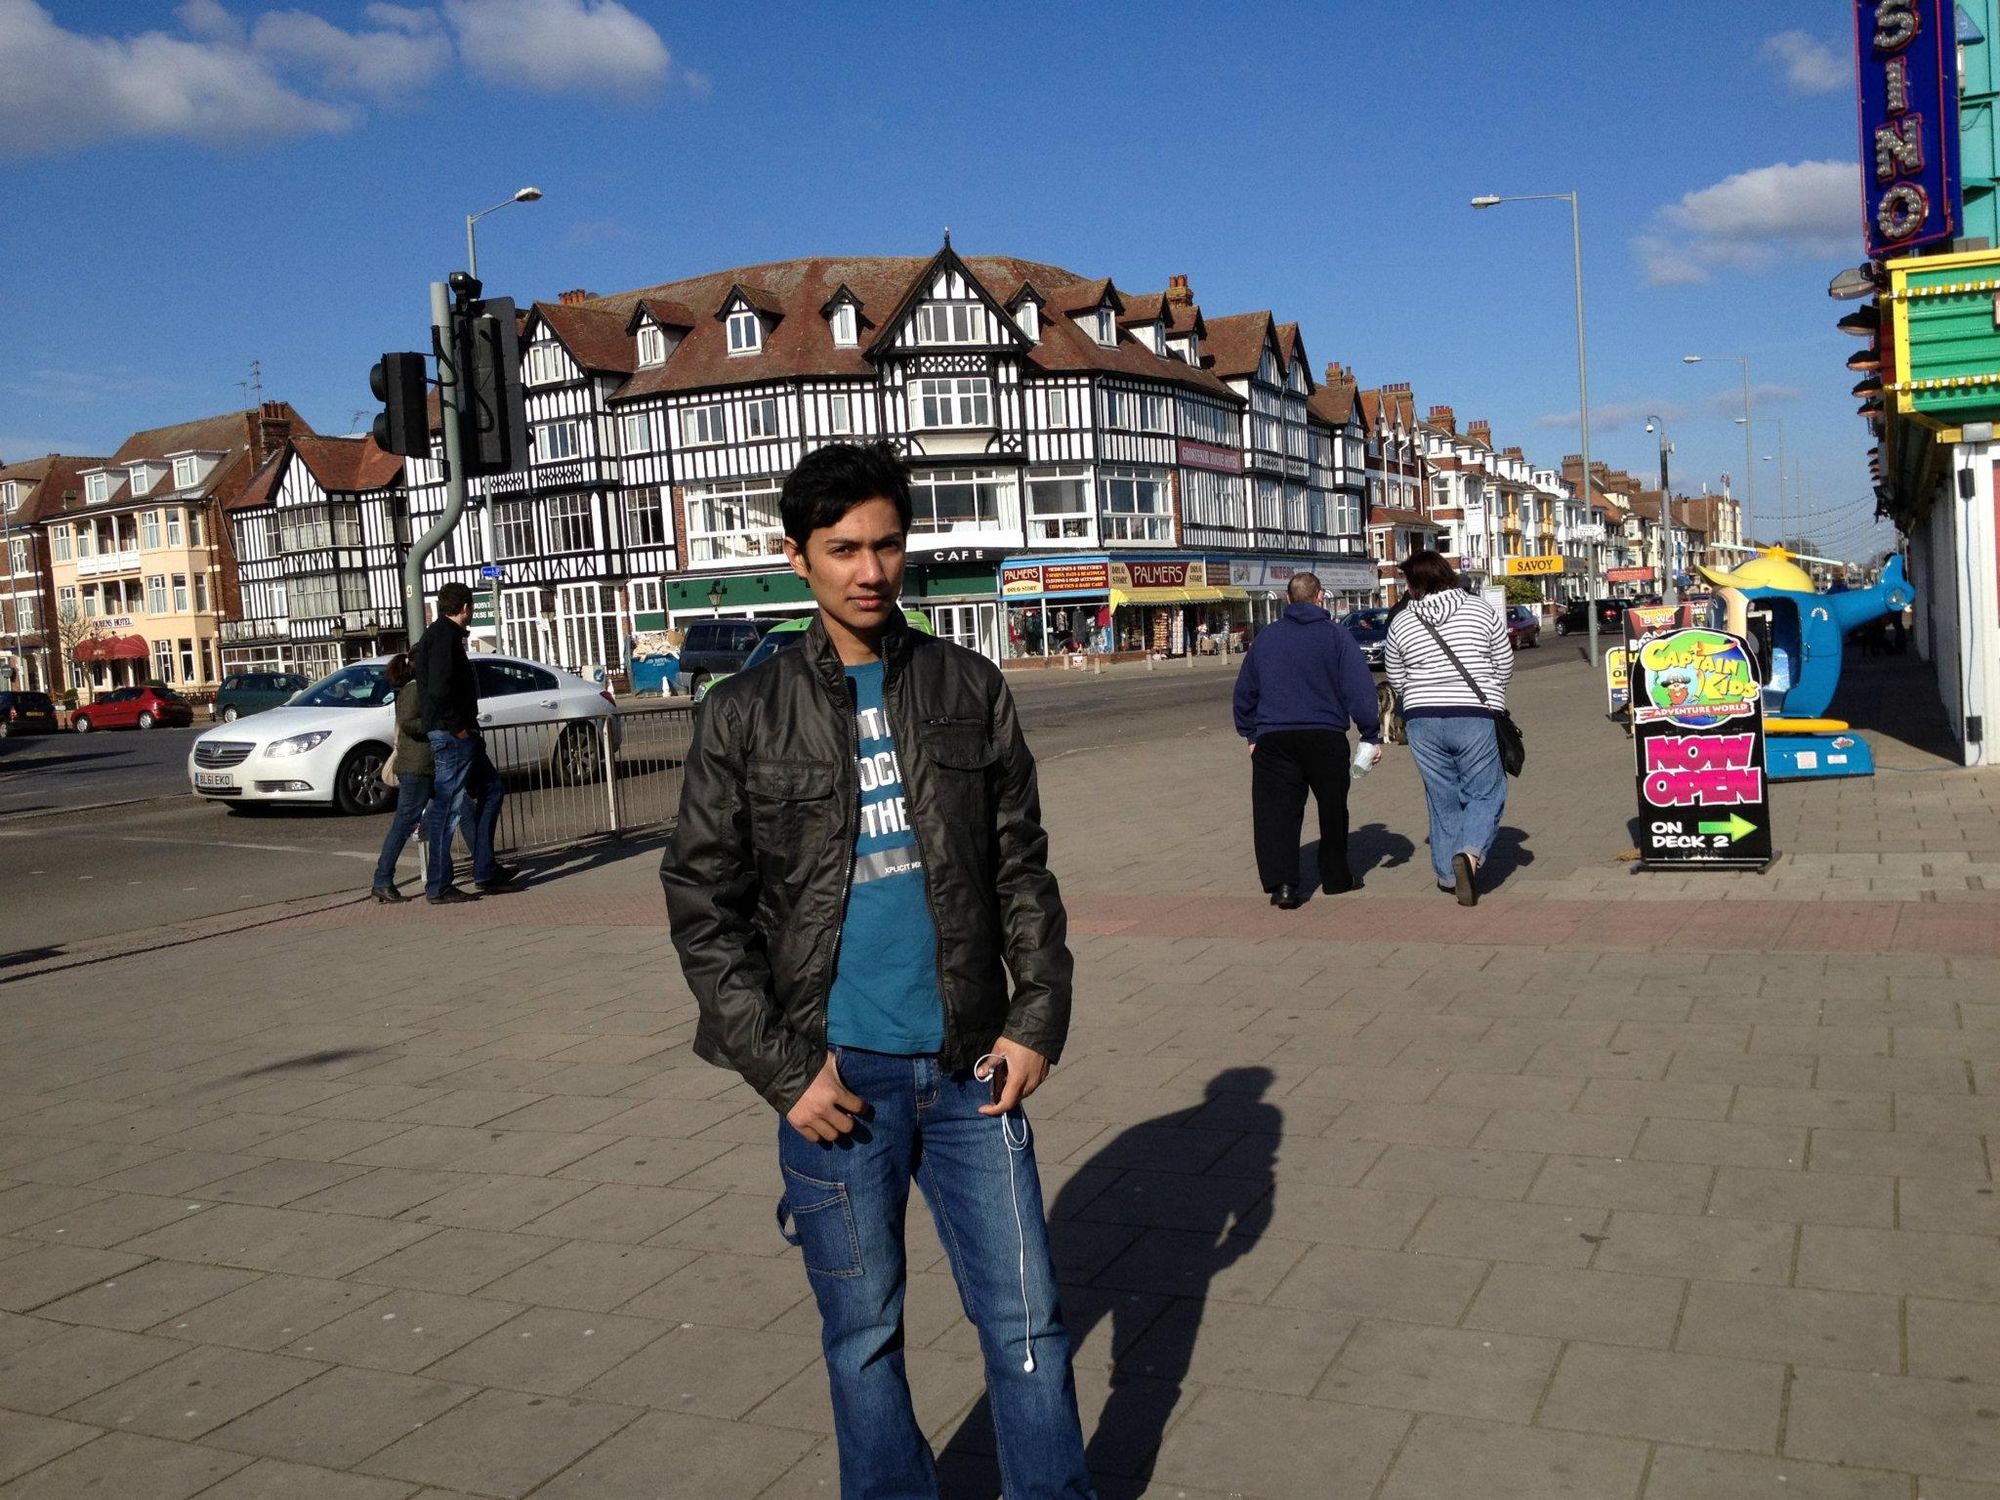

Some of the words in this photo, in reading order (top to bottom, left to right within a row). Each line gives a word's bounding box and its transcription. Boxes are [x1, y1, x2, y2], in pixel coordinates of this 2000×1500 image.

[933, 550, 983, 561] CAFE
[1517, 559, 1554, 572] SAVOY
[1004, 569, 1038, 580] PALMERS
[1134, 566, 1183, 584] PALMERS
[1642, 641, 1739, 675] CAPTAIN
[1704, 673, 1758, 700] KIDS
[1654, 705, 1711, 716] ADVENTURE
[1712, 703, 1748, 712] WORLD
[1644, 732, 1755, 773] NOW
[1643, 767, 1762, 807] OPEN
[861, 797, 911, 838] THE
[1651, 821, 1682, 834] ON
[1652, 835, 1706, 848] DECK
[1713, 835, 1729, 848] 2
